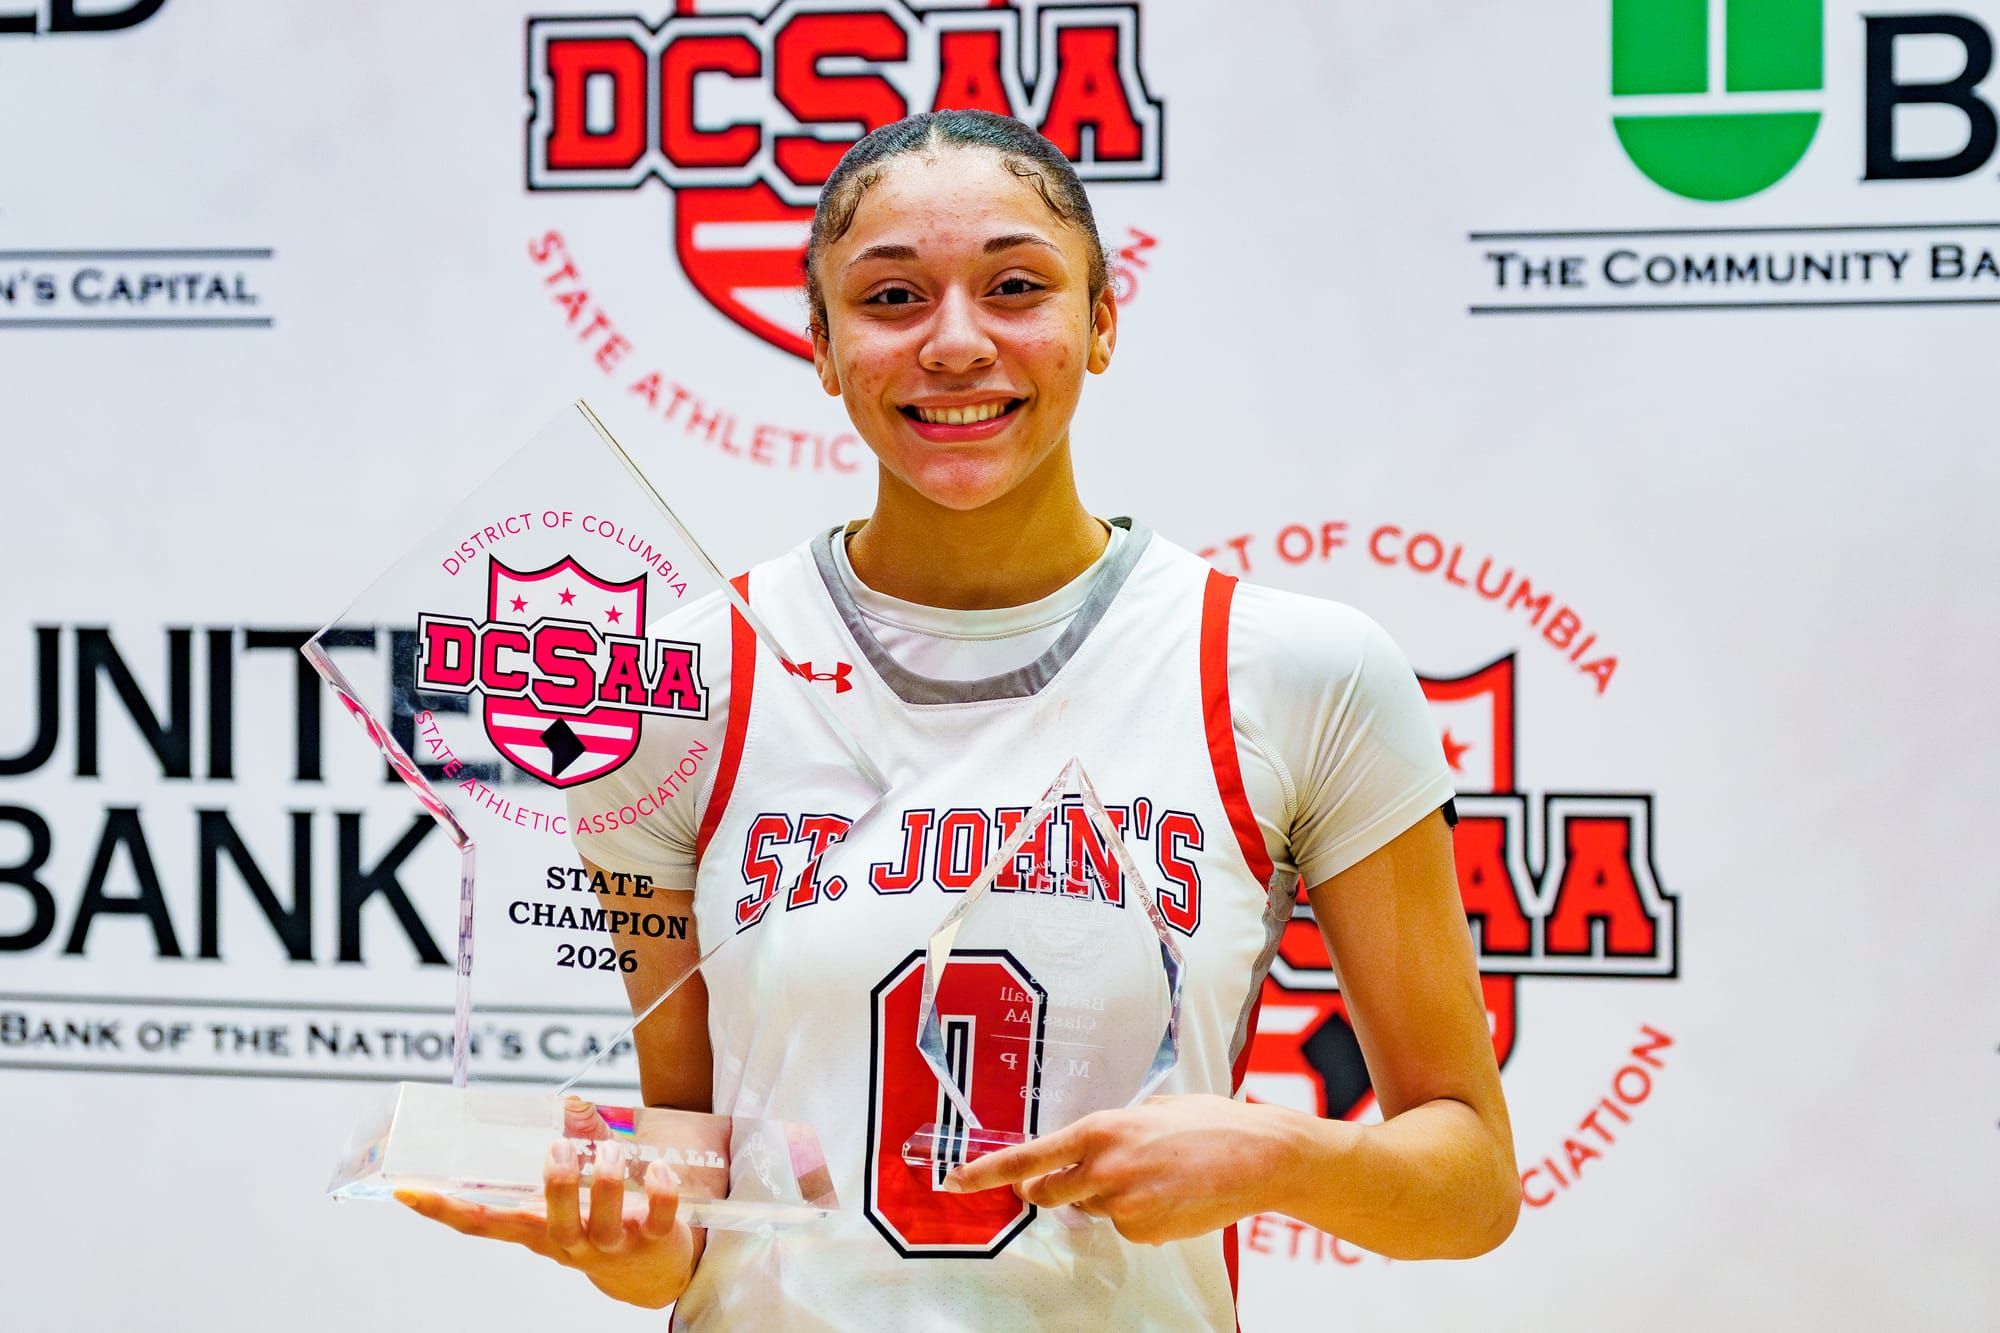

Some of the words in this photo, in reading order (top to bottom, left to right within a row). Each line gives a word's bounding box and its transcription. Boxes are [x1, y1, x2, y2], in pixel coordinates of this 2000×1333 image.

[527, 3, 1163, 206] DCSAA
[71, 268, 259, 306] CAPITAL
[1486, 251, 1587, 289] THE
[1603, 248, 1909, 288] COMMUNITY
[1929, 243, 2000, 280] BA
[527, 229, 635, 375] STATE
[627, 370, 864, 474] ATHLETIC
[442, 513, 532, 576] DISTRICT
[542, 510, 573, 529] OF
[582, 515, 688, 599] COLUMBIA
[1275, 521, 1349, 566] OF
[1368, 524, 1619, 696] COLUMBIA
[415, 612, 709, 721] DCSAA
[414, 710, 462, 778] STATE
[459, 777, 567, 834] ATHLETIC
[576, 740, 709, 835] ASSOCIATION
[508, 901, 690, 940] CHAMPION
[546, 866, 656, 899] STATE
[735, 813, 854, 935] ST.
[869, 794, 1204, 938] JOHN'S
[556, 943, 640, 974] 2026
[0, 1010, 121, 1050] BANK
[137, 1020, 192, 1052] OF
[210, 1023, 290, 1056] THE
[864, 949, 1048, 1259] 0
[1519, 1023, 1675, 1209] CIATION
